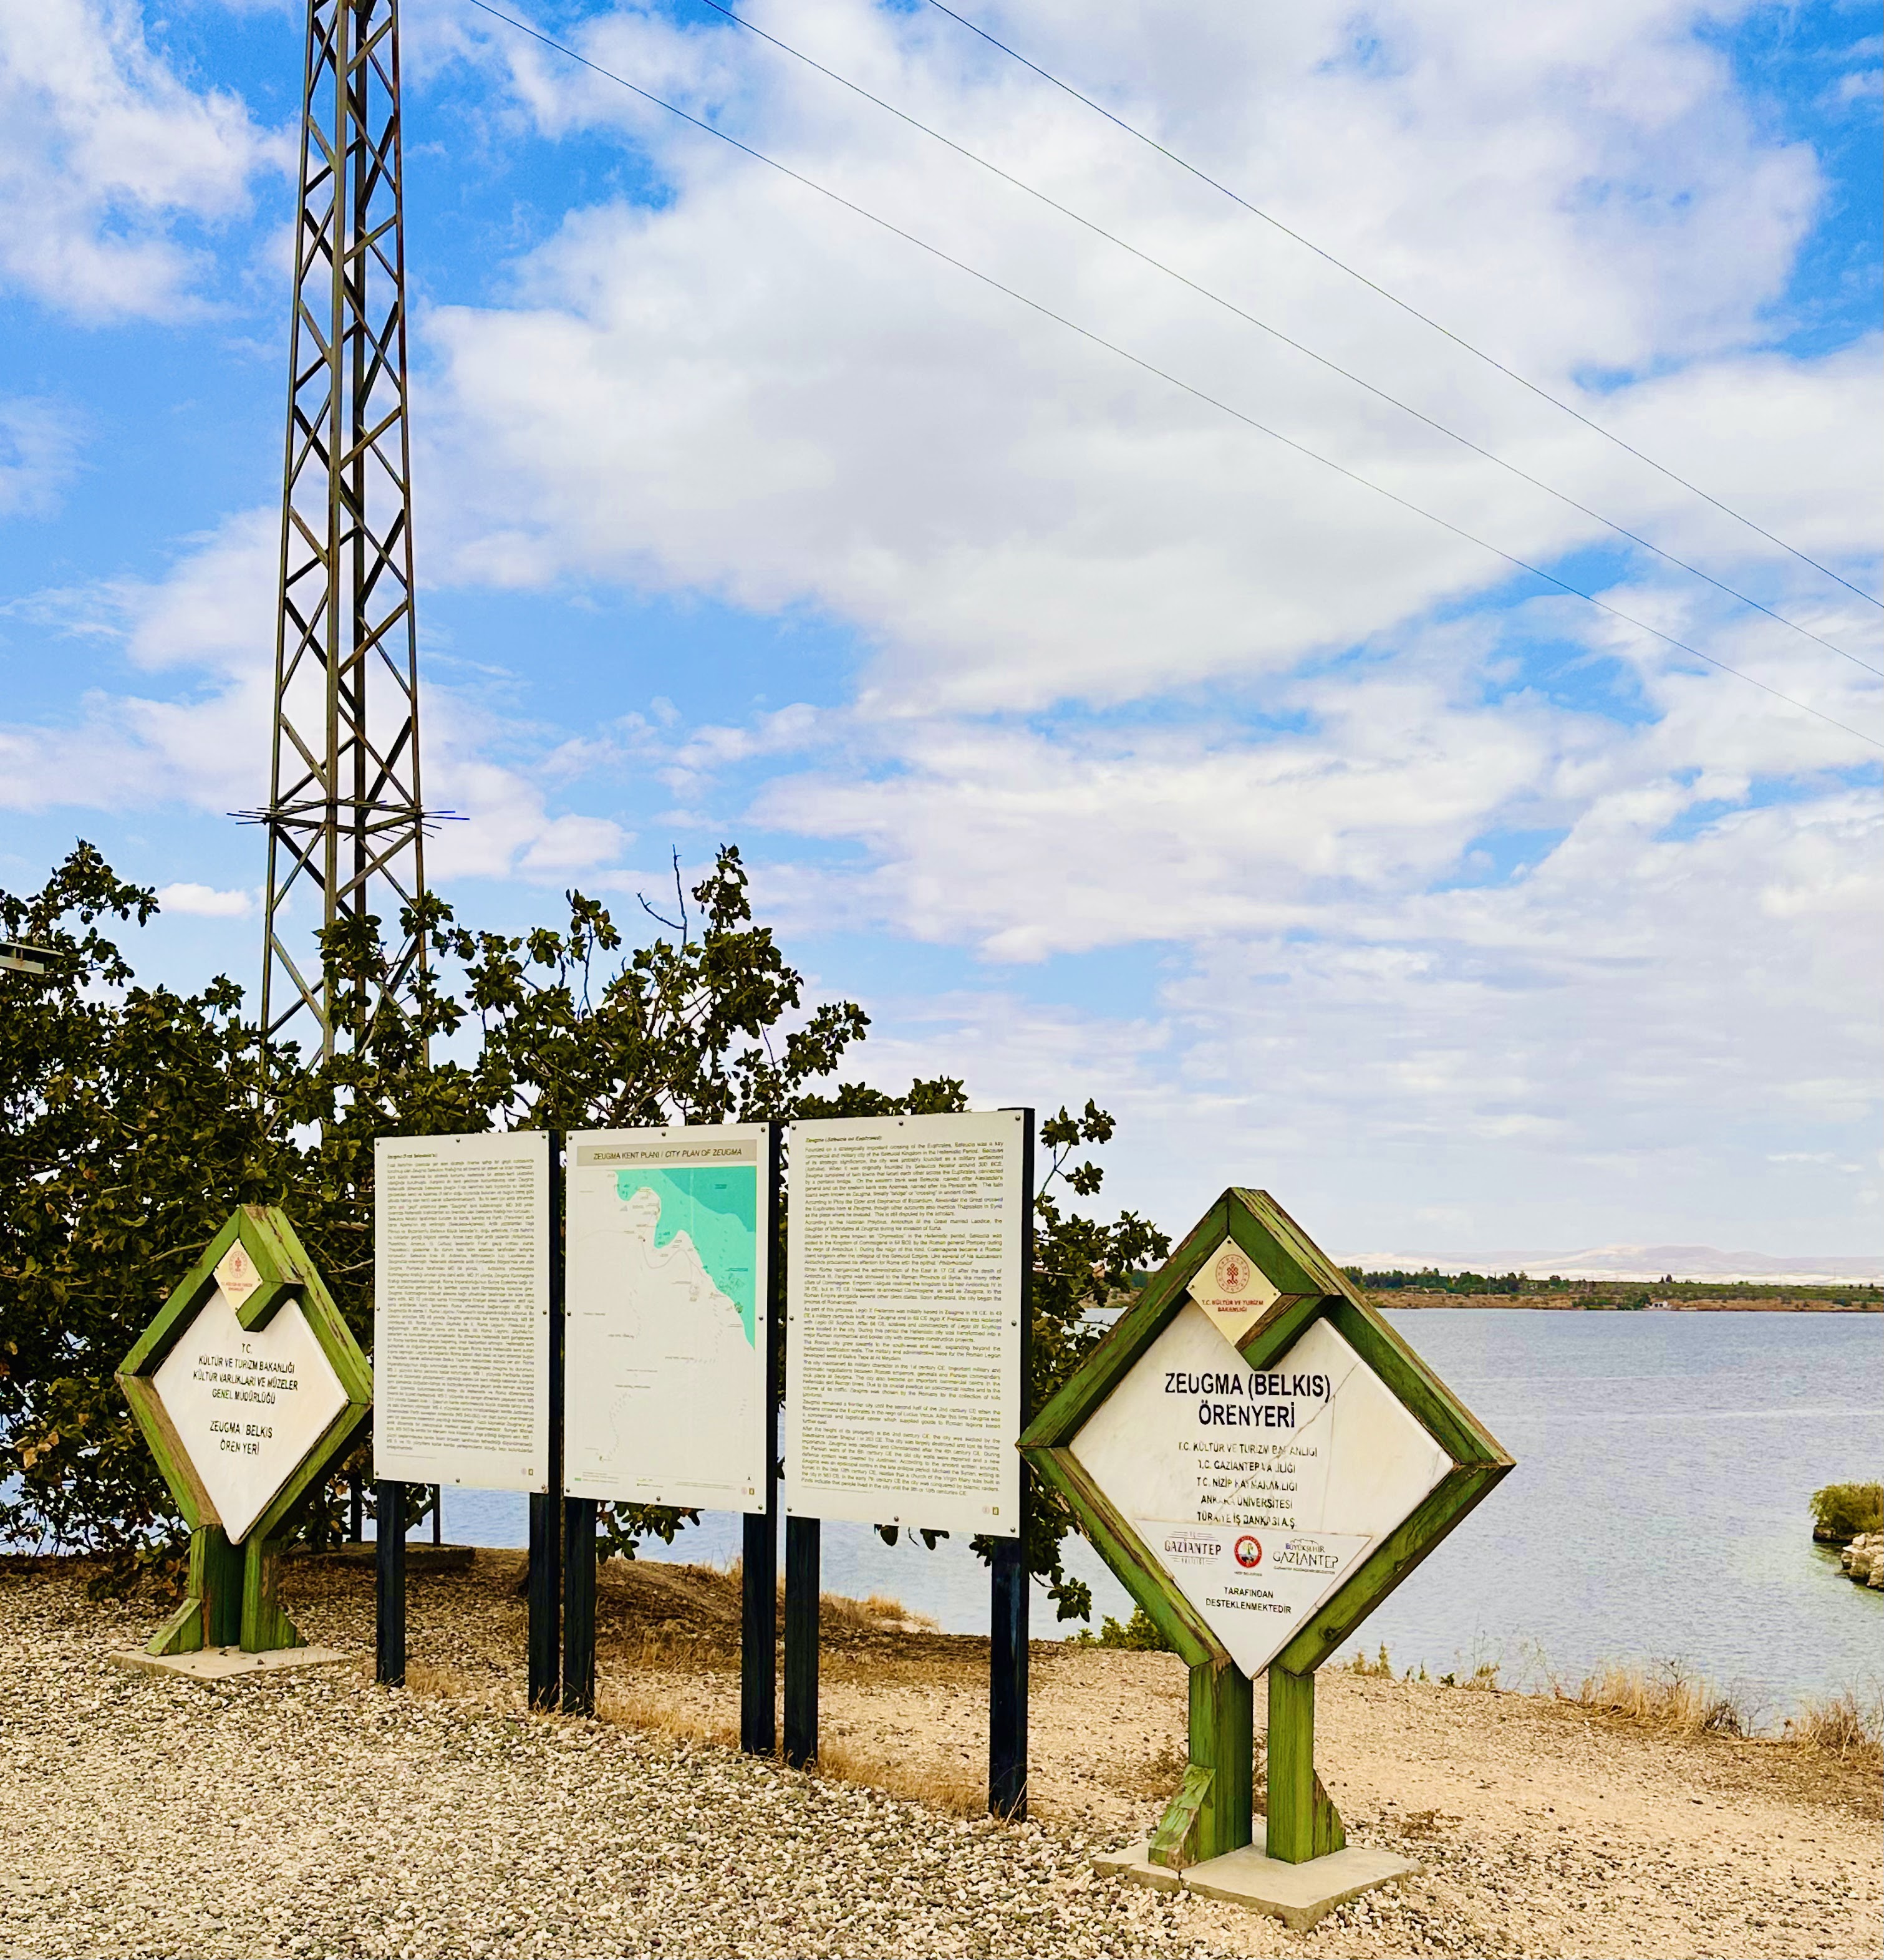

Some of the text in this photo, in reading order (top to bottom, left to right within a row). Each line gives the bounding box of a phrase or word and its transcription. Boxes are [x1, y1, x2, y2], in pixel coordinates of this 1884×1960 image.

[712, 1148, 742, 1156] ZEUGMA
[199, 1354, 295, 1374] KÜLTÜR VE TURİZM BAKANLIĞI
[193, 1368, 298, 1391] KÜLTÜR VARLIKLARI VE MÜZELER
[212, 1388, 276, 1404] GENEL MÜDÜRLÜĞÜ
[1165, 1373, 1330, 1403] ZEUGMA (BELKIS)
[1199, 1399, 1295, 1428] ÖRENYERİ
[210, 1420, 240, 1434] ZEUGMA
[246, 1424, 273, 1438] BELKIS
[220, 1438, 260, 1455] ÖREN YERİ
[1193, 1440, 1224, 1453] KÜLTÜR
[1227, 1443, 1237, 1452] VE
[1239, 1442, 1269, 1454] TURİZM
[1214, 1459, 1260, 1471] GAZİANTEP
[1212, 1476, 1232, 1489] NİZİP
[1237, 1495, 1293, 1509] ÜNİVERSİTESİ
[1164, 1538, 1221, 1555] GAZİANTEP
[1273, 1551, 1339, 1568] GAZİANTEP
[1224, 1586, 1273, 1598] TARAFINDAN
[1205, 1598, 1292, 1614] DESTEKLENMEKTEDİR
